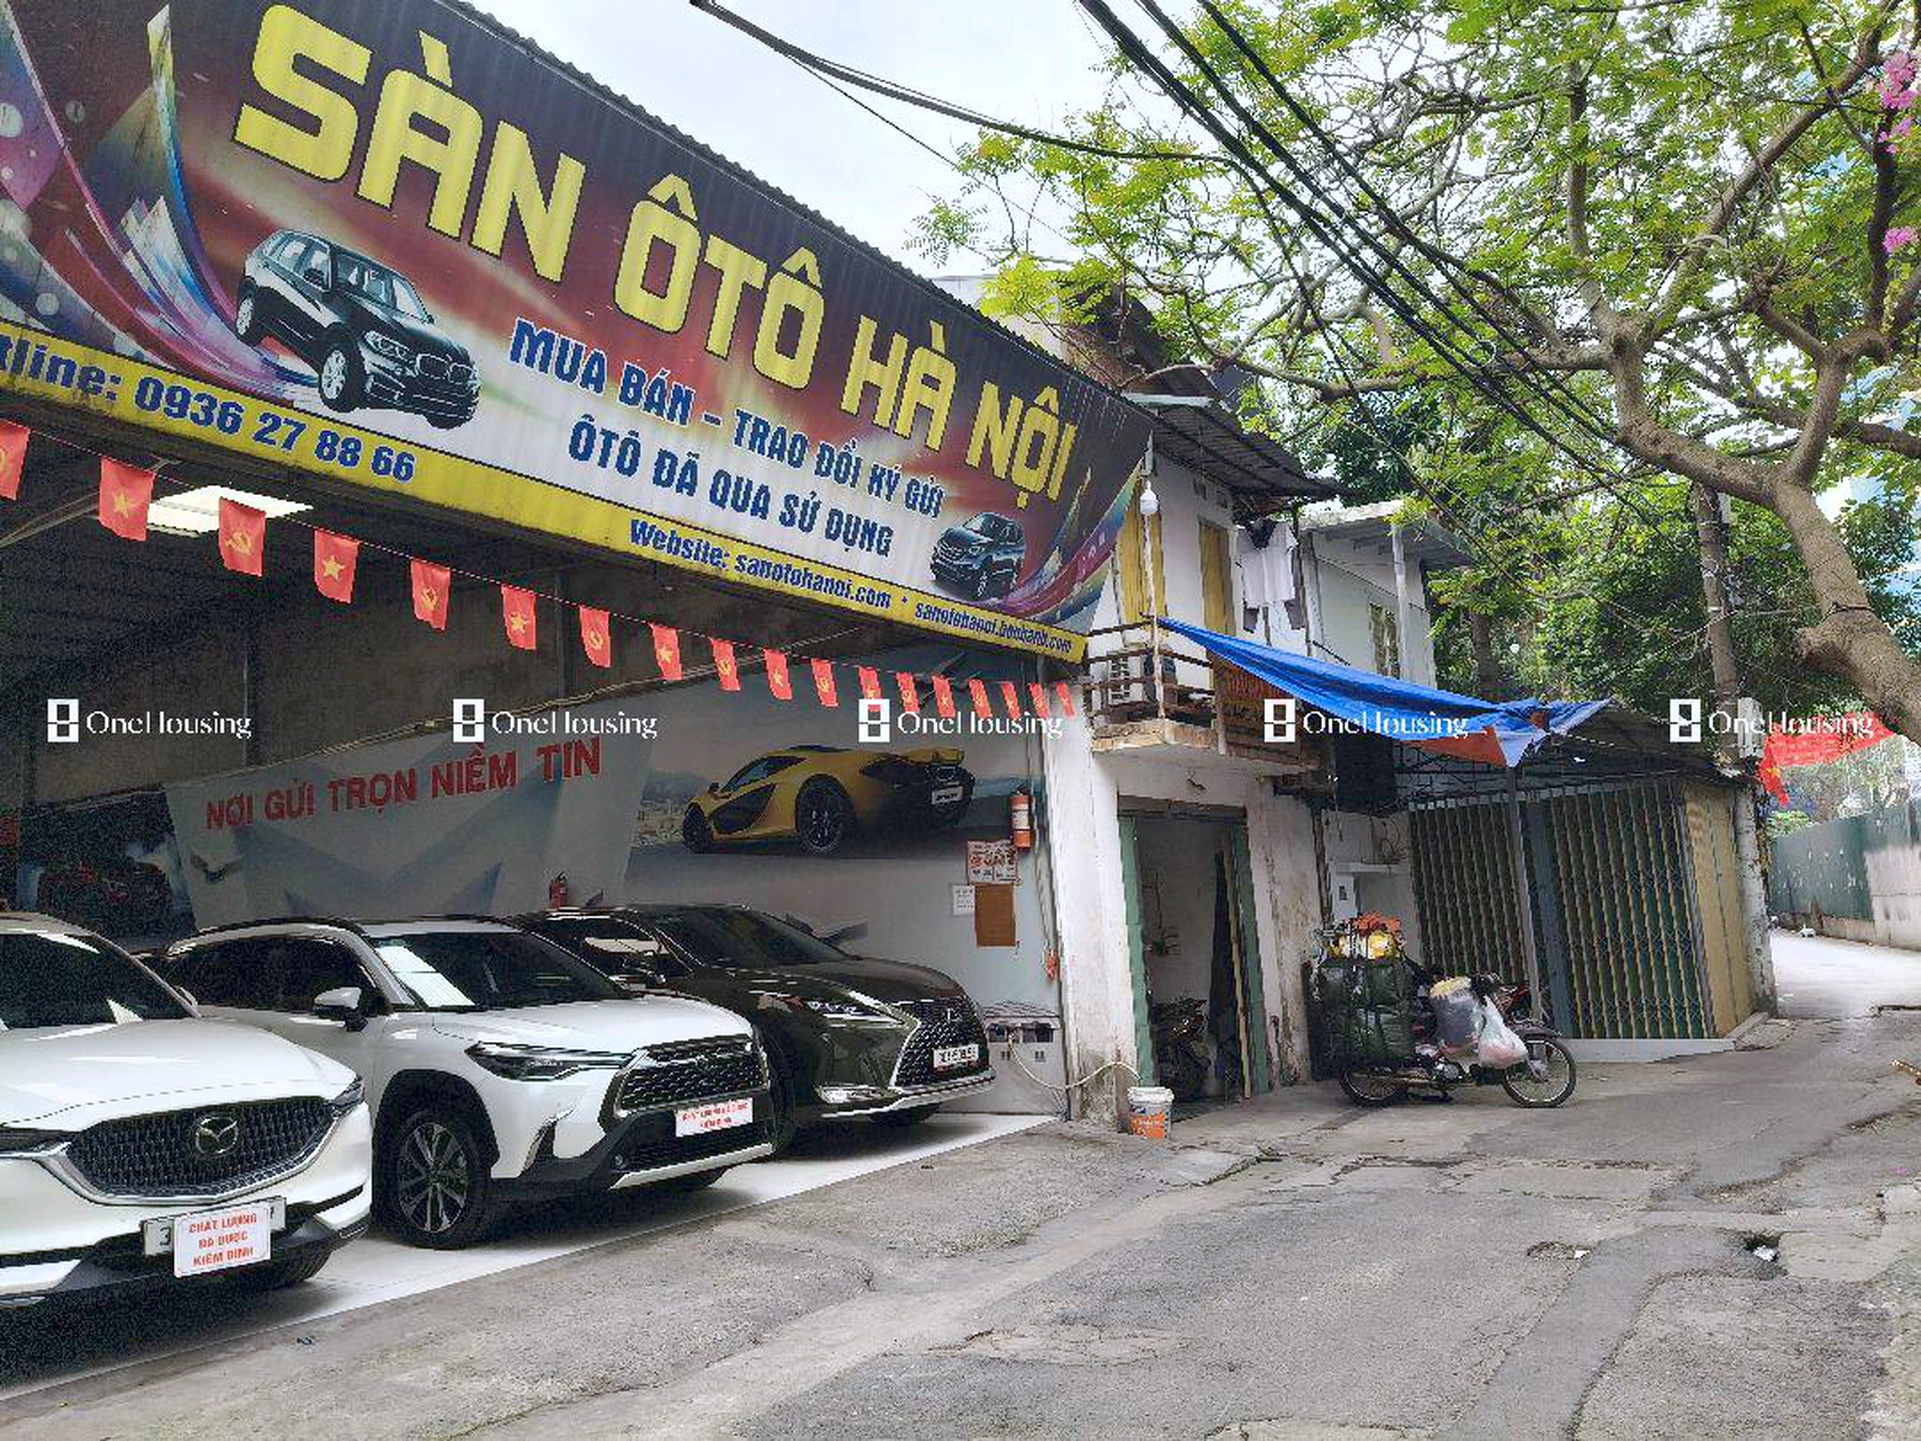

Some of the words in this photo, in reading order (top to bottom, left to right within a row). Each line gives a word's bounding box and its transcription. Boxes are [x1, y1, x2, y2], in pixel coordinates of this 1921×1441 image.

[233, 4, 587, 283] SÀN
[614, 172, 824, 391] ÔTÔ
[840, 316, 957, 453] HÀ
[965, 381, 1077, 508] NỘI
[135, 376, 244, 435] 0936
[252, 411, 306, 451] 27
[314, 429, 362, 468] 88
[371, 445, 415, 483] 66
[510, 318, 607, 394] MUA
[618, 368, 695, 426] BÁN
[734, 408, 808, 469] TRAO
[813, 438, 863, 488] ĐỔI
[867, 464, 901, 502] KÝ
[904, 475, 944, 519] GỬI
[568, 413, 642, 478] ÔTÔ
[652, 448, 699, 497] ĐÃ
[708, 468, 771, 521] QUA
[778, 490, 822, 534] SỬ
[825, 508, 893, 558] DỤNG
[630, 518, 731, 569] Website:
[735, 554, 891, 609] sanotohanoi.com
[327, 767, 417, 815] TRỌN
[431, 742, 517, 797] NIỀM
[536, 736, 600, 784] TIN
